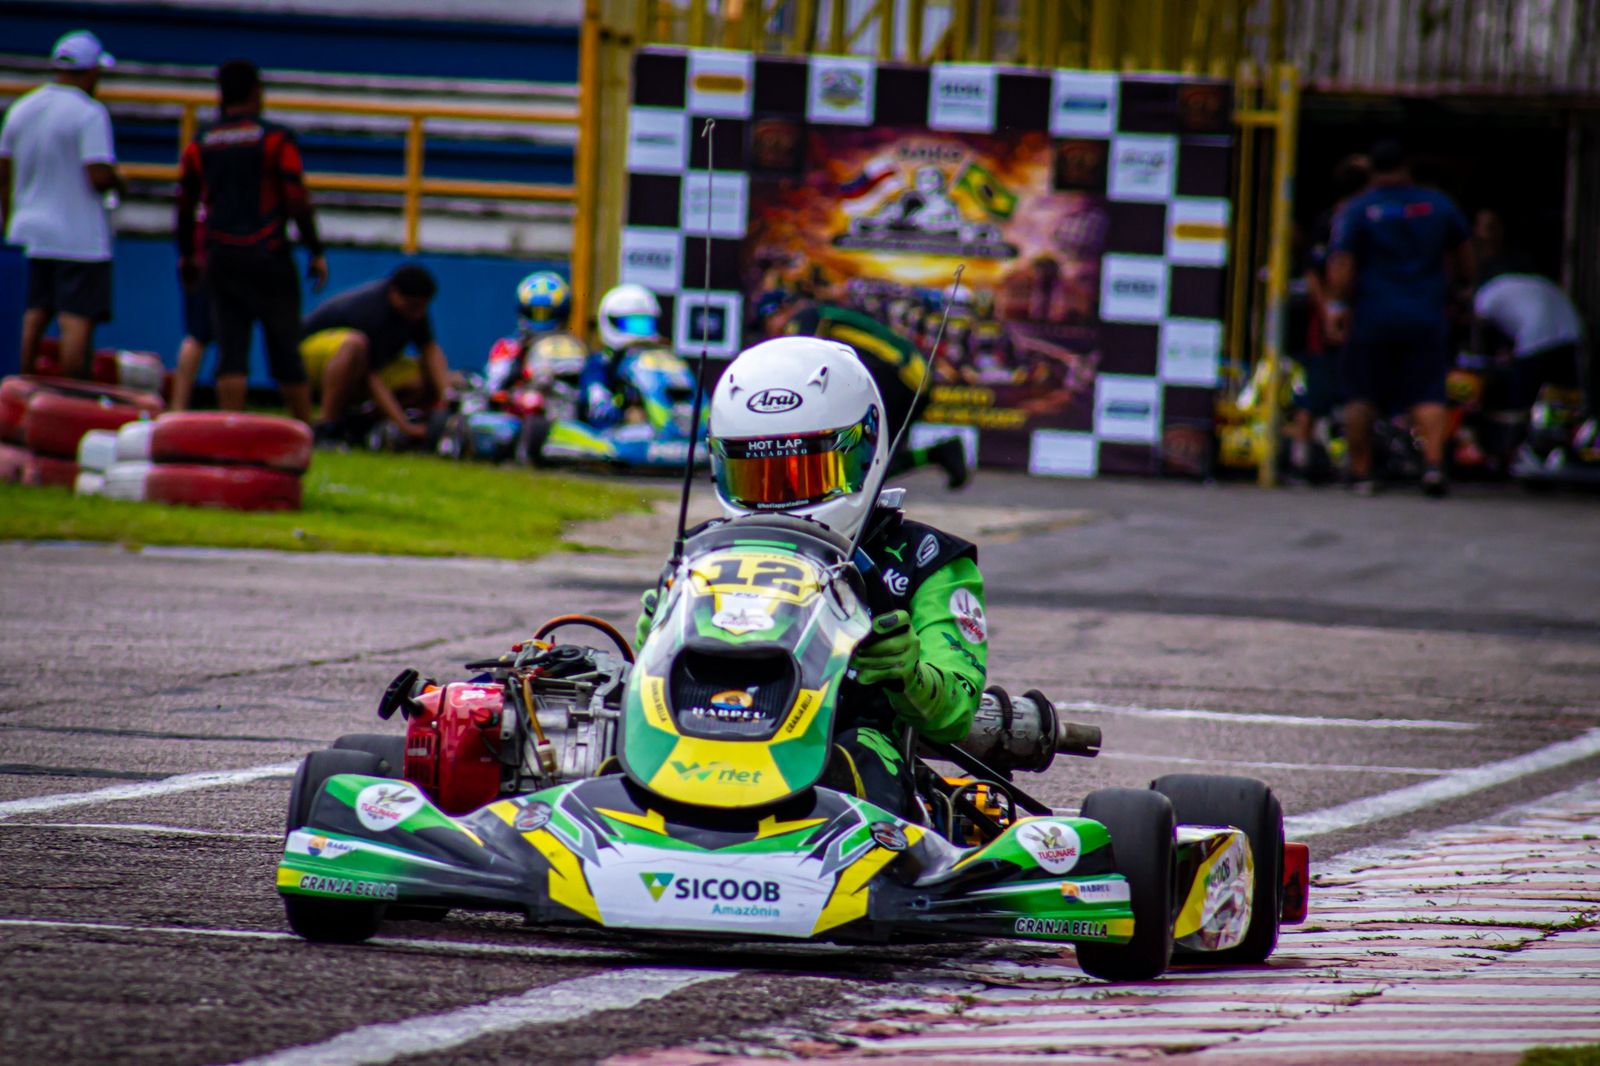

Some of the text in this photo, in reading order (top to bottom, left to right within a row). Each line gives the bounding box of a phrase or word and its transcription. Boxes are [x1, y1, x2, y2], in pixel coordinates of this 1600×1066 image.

[752, 390, 796, 408] Arai
[745, 448, 808, 458] PALADINO
[748, 439, 803, 451] HOT LAP
[705, 559, 805, 597] 12
[883, 568, 910, 597] Ke
[299, 875, 398, 900] GRANJA BELLA
[675, 877, 781, 903] SICOOB
[712, 903, 780, 917] Amazônia
[1015, 917, 1108, 938] GRANJA BELLA
